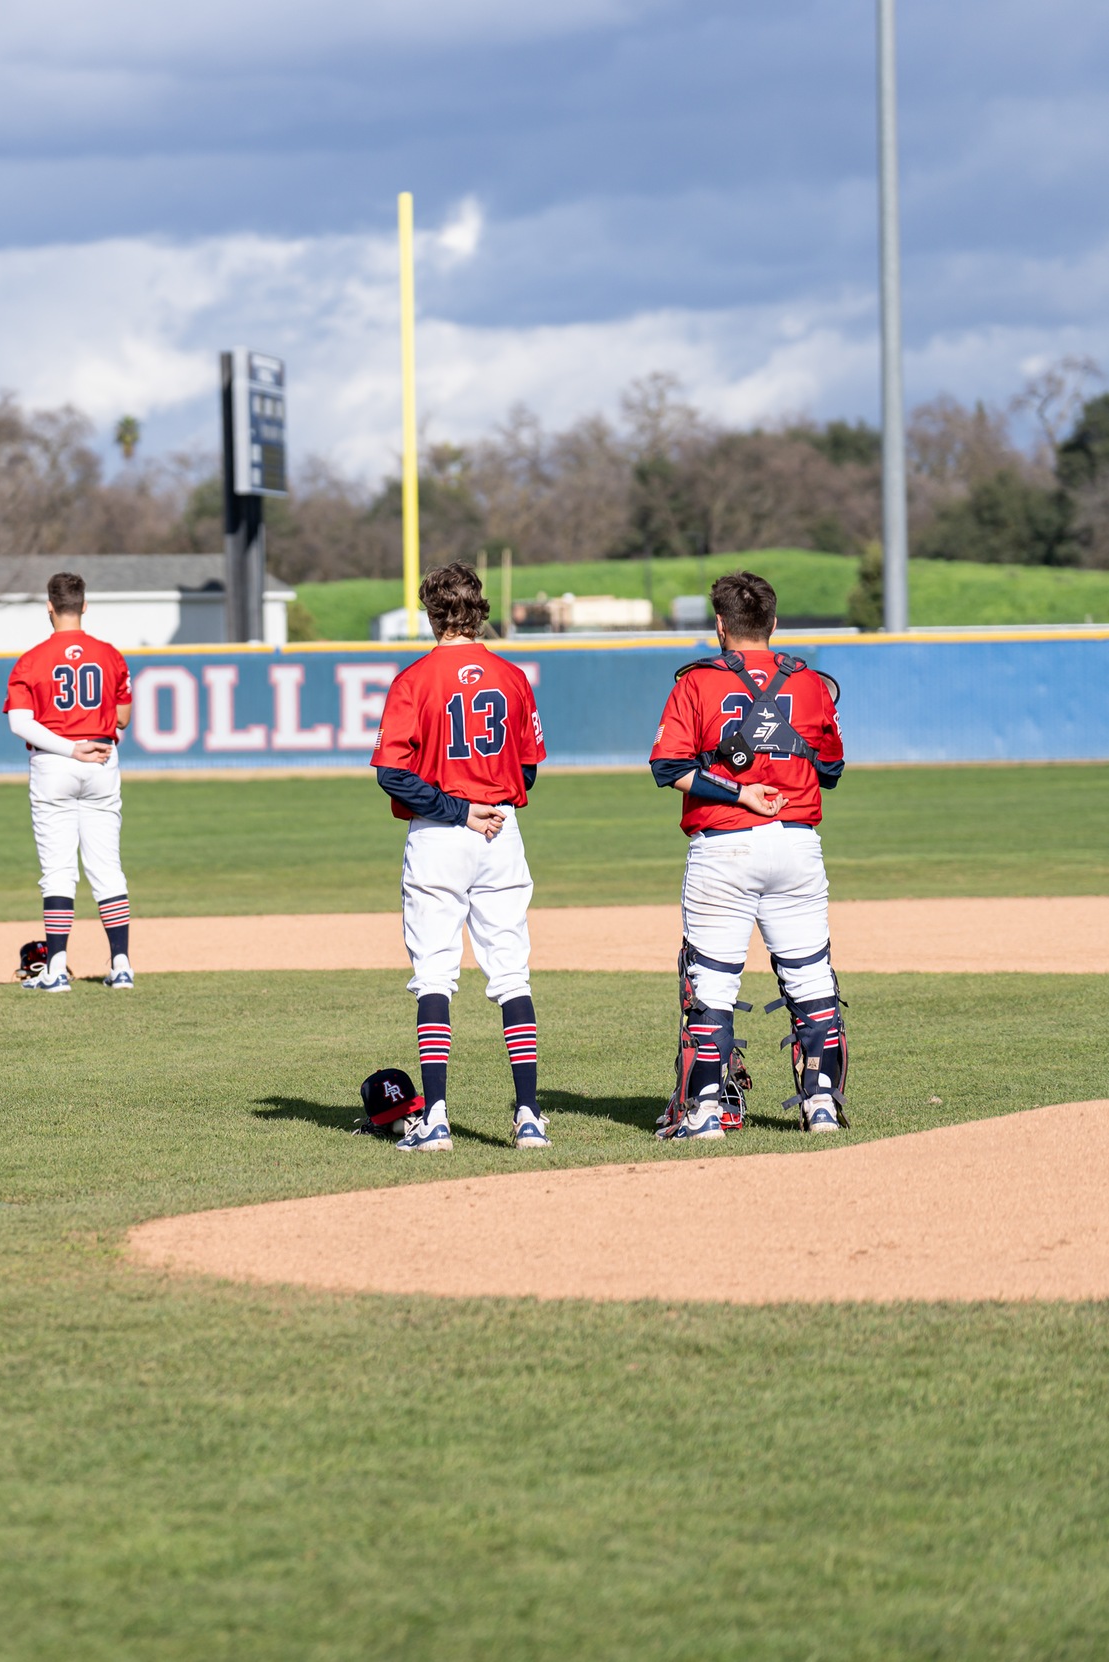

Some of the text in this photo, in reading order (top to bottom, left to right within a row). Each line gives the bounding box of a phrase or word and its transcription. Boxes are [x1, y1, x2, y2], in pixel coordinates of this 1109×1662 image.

[52, 662, 104, 711] 30
[446, 689, 508, 760] 13
[383, 1081, 404, 1102] AR
